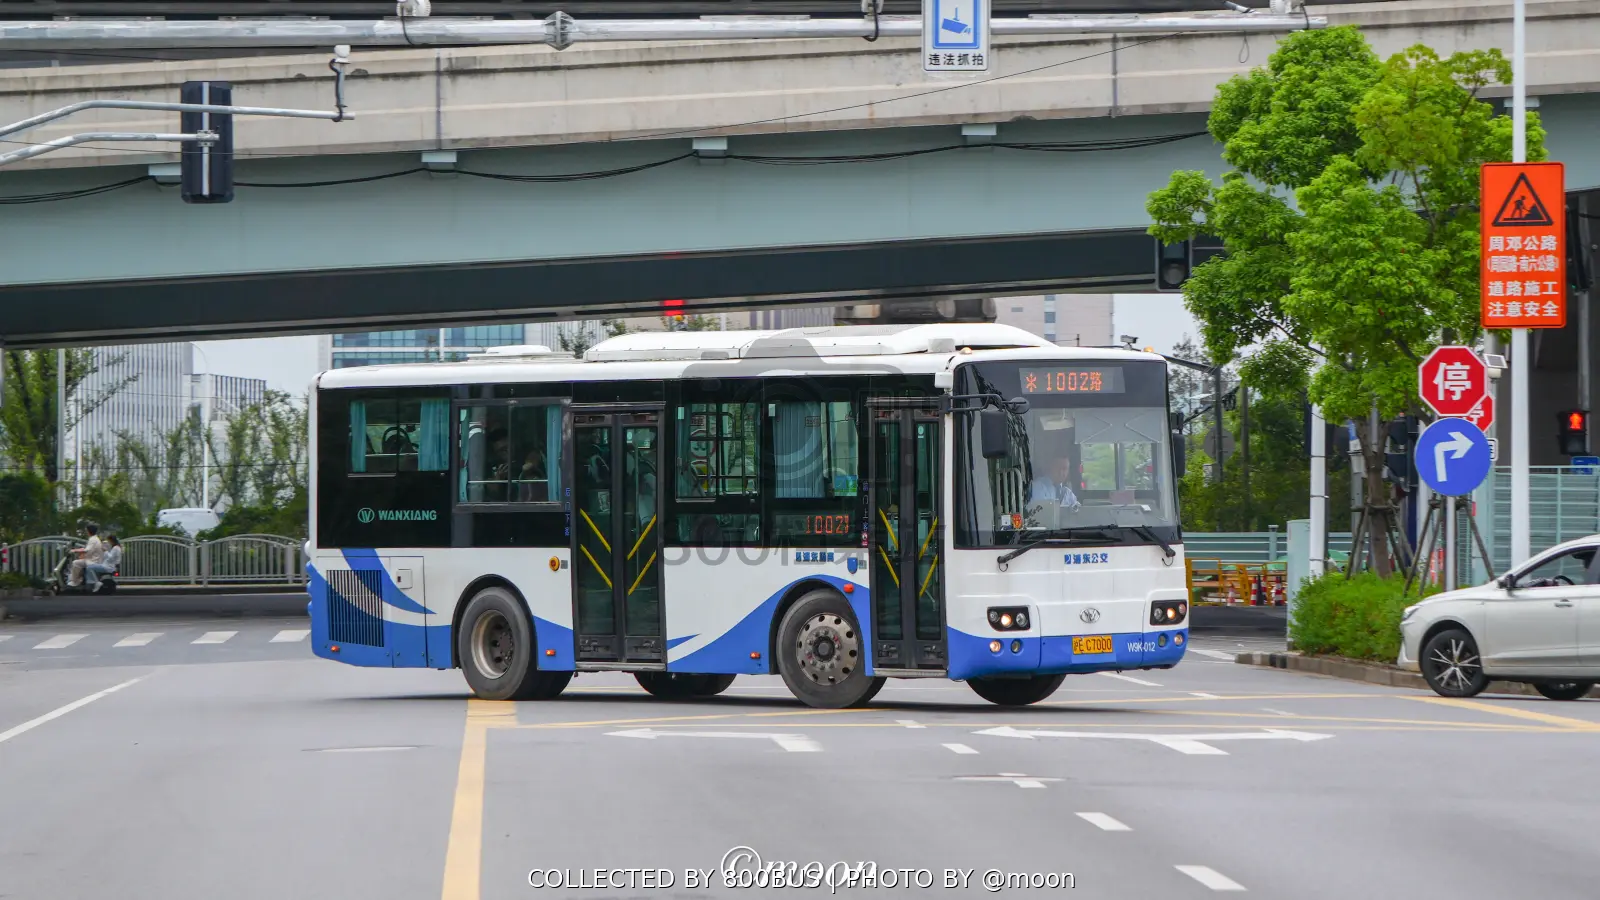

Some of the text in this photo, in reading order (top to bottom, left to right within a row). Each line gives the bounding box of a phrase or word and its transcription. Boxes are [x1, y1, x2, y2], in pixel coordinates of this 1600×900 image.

[928, 53, 984, 66] 违法抓拍
[1488, 235, 1558, 251] 周邓公路
[1488, 280, 1559, 296] 道路施工
[1488, 301, 1559, 317] 注意安全
[1046, 371, 1102, 392] 1002路
[1433, 362, 1472, 401] 停
[378, 510, 437, 521] WANXIANG
[1086, 638, 1112, 651] C7000
